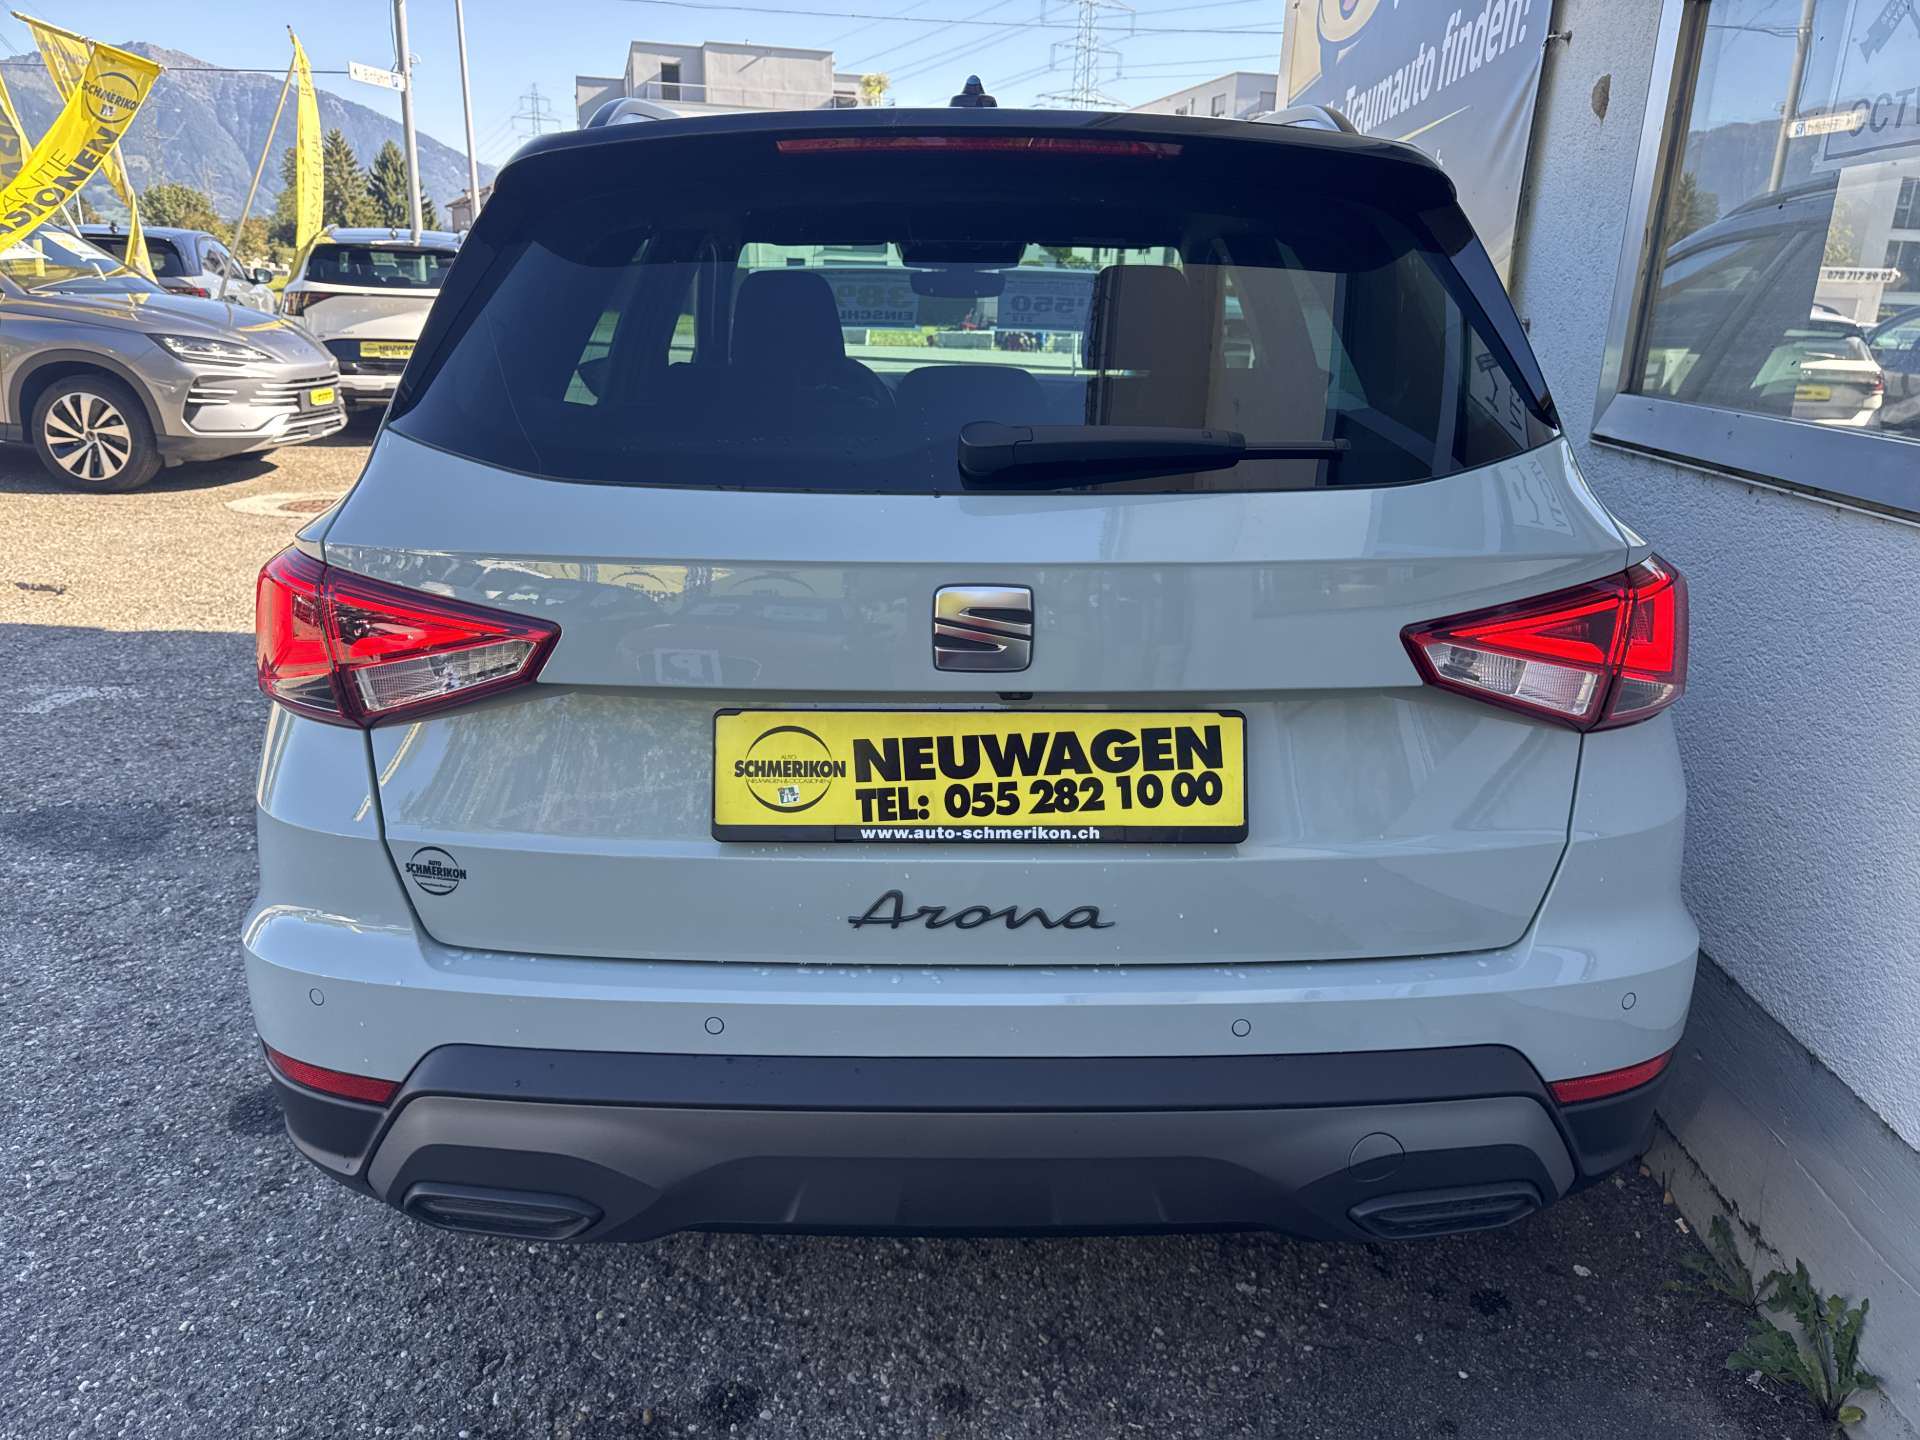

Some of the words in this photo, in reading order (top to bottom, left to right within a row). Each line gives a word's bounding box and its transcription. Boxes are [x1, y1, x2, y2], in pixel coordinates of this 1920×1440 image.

[1345, 41, 1436, 134] Traumauto
[1436, 0, 1530, 92] finden!
[81, 81, 140, 111] SCHMERIKO
[0, 148, 73, 216] ANTIE
[734, 760, 846, 777] SCHMERIKON
[853, 725, 1223, 782] NEUWAGEN
[855, 786, 930, 823] TEL:
[944, 781, 1020, 819] 055
[1028, 776, 1105, 814] 282
[1116, 773, 1163, 809] 10
[1171, 770, 1223, 807] 00
[860, 826, 1100, 840] www.auto-schmerikon.ch
[405, 862, 467, 880] SCHMERIKON
[848, 889, 1116, 929] Arona
